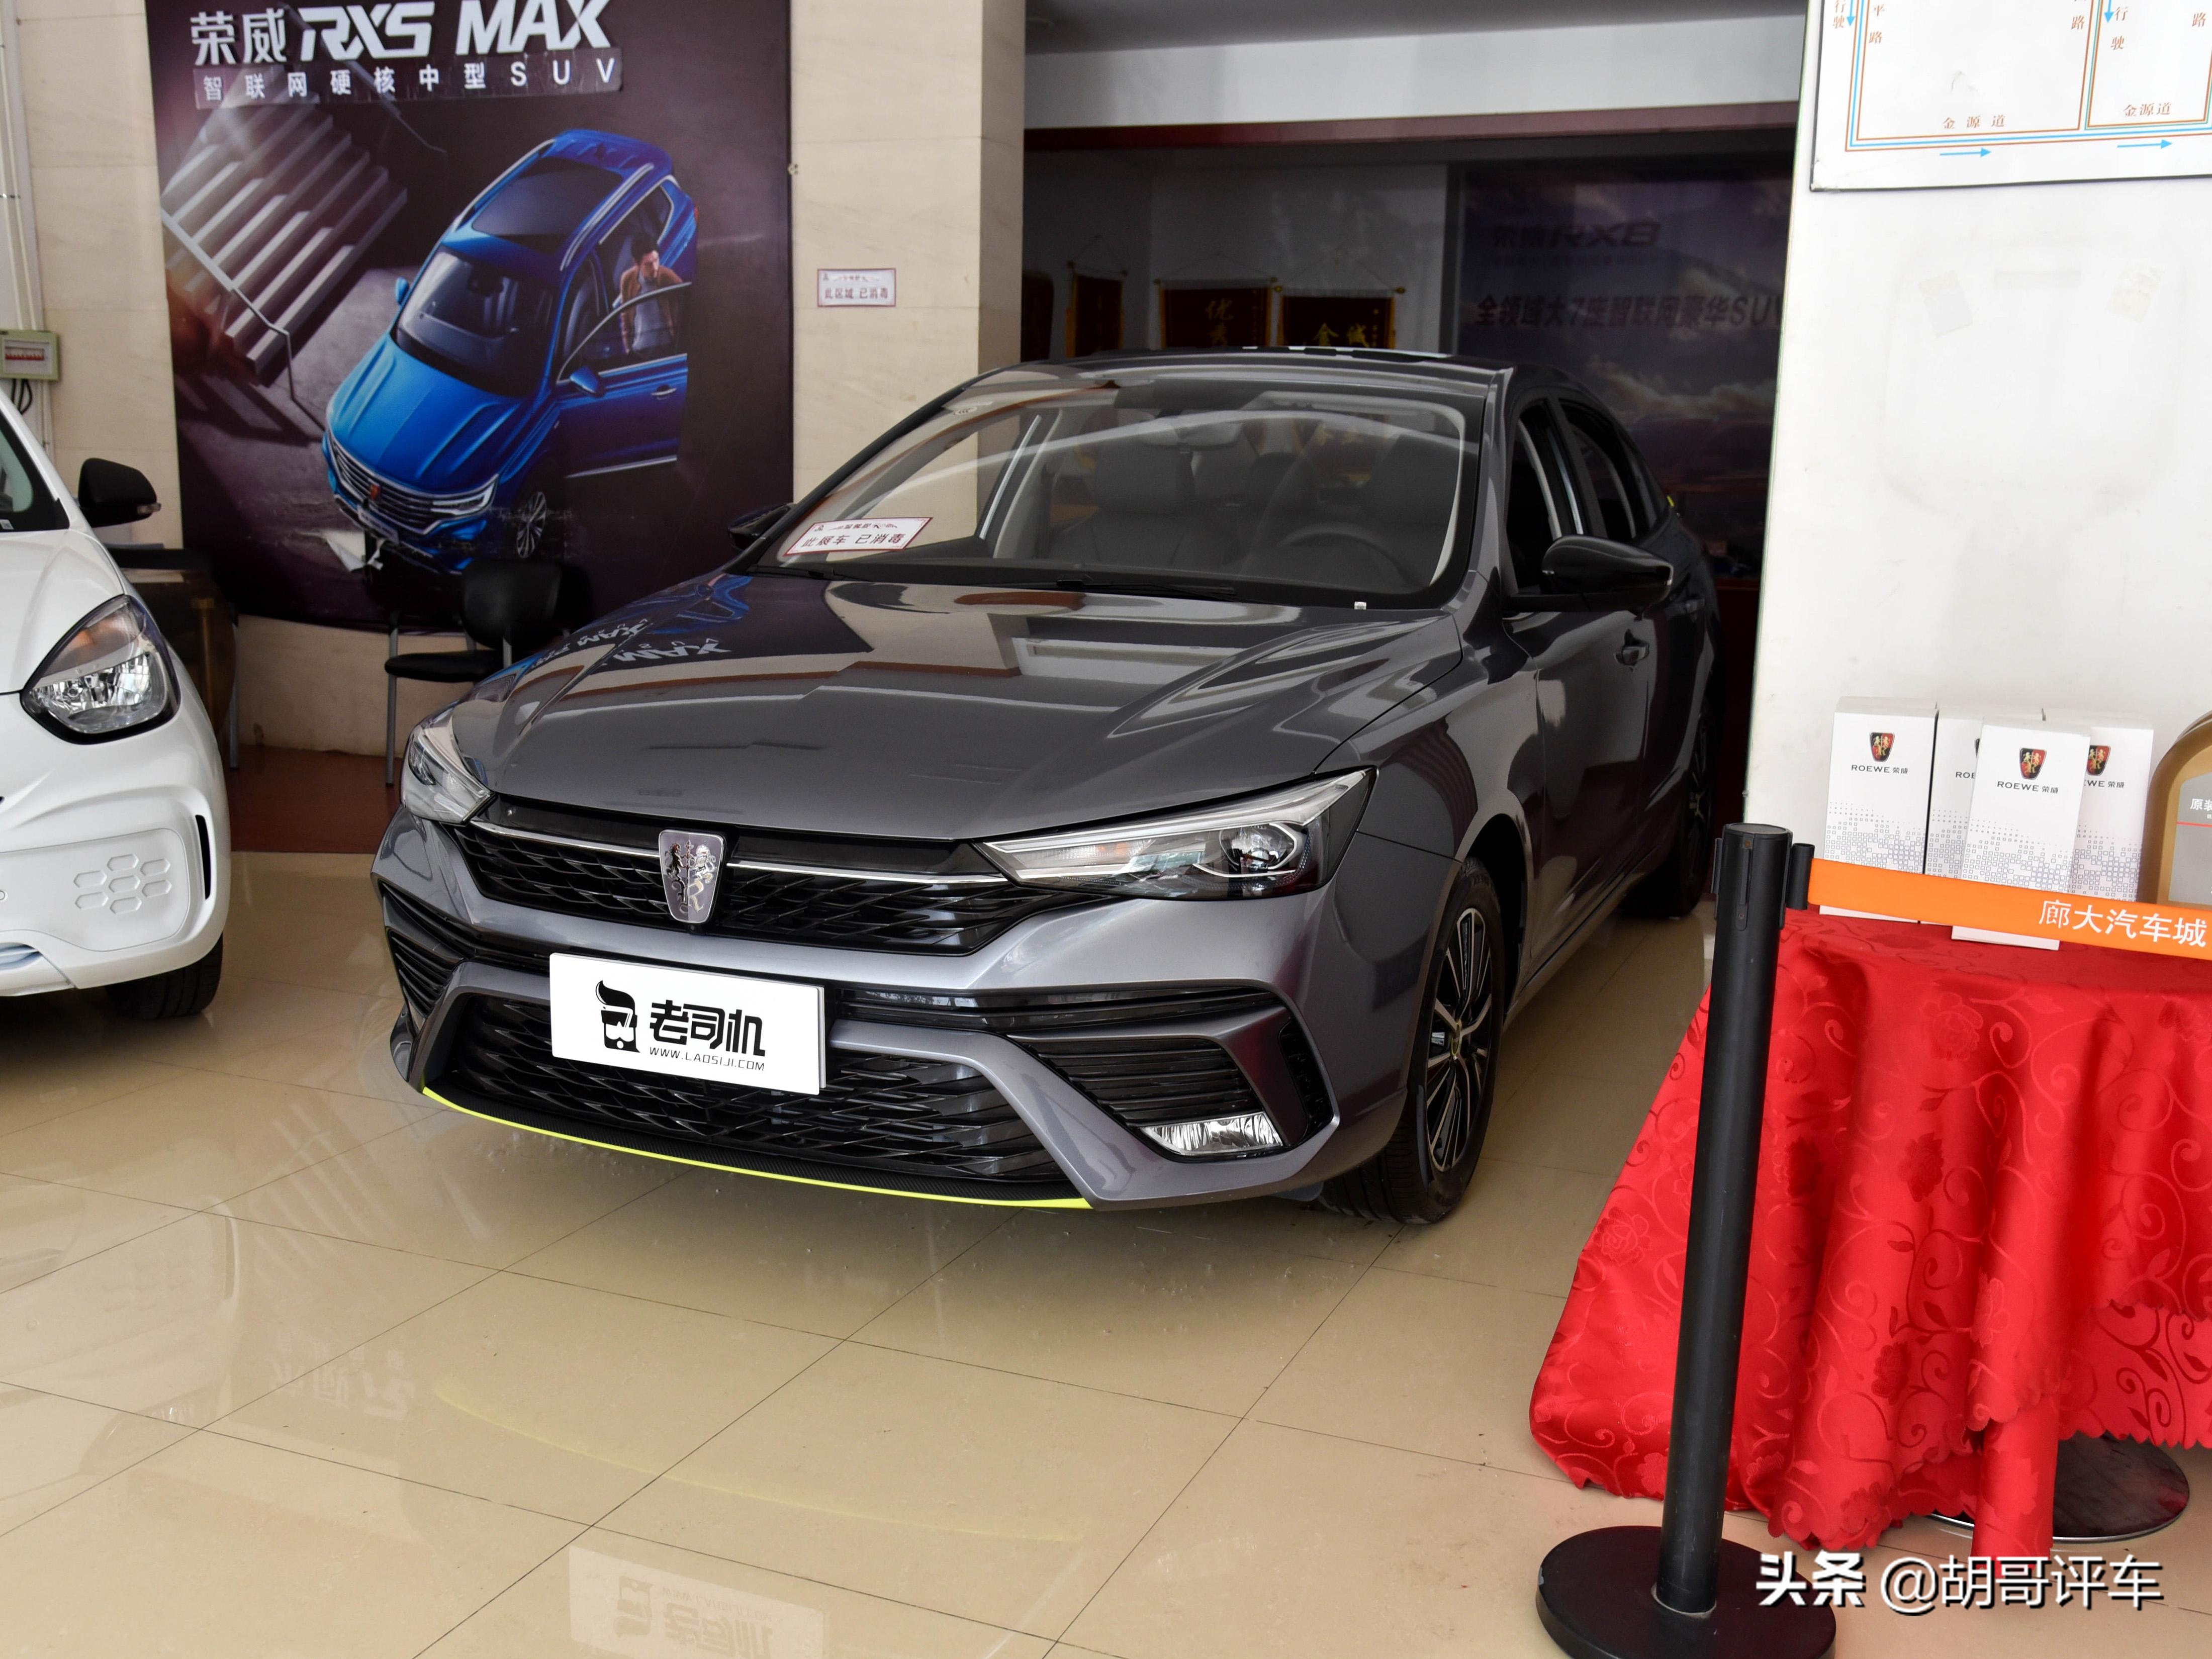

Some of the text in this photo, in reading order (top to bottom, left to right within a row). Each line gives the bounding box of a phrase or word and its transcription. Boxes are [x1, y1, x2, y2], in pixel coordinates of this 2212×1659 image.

[2192, 12, 2206, 28] 路
[191, 8, 287, 66] 荣威
[455, 0, 611, 56] MAX
[2123, 102, 2171, 117] 金源道
[1943, 114, 2006, 130] 金源道
[859, 287, 888, 299] 已消毒
[855, 533, 906, 544] 已消毒
[1851, 764, 1890, 773] ROEWE
[1997, 781, 2059, 794] ROEWE 荣威
[2084, 780, 2125, 789] WE 荣威
[2039, 899, 2207, 947] 廊大汽车城
[650, 999, 766, 1057] 老司机
[650, 1047, 765, 1072] WWW.LAOSIJI.COM
